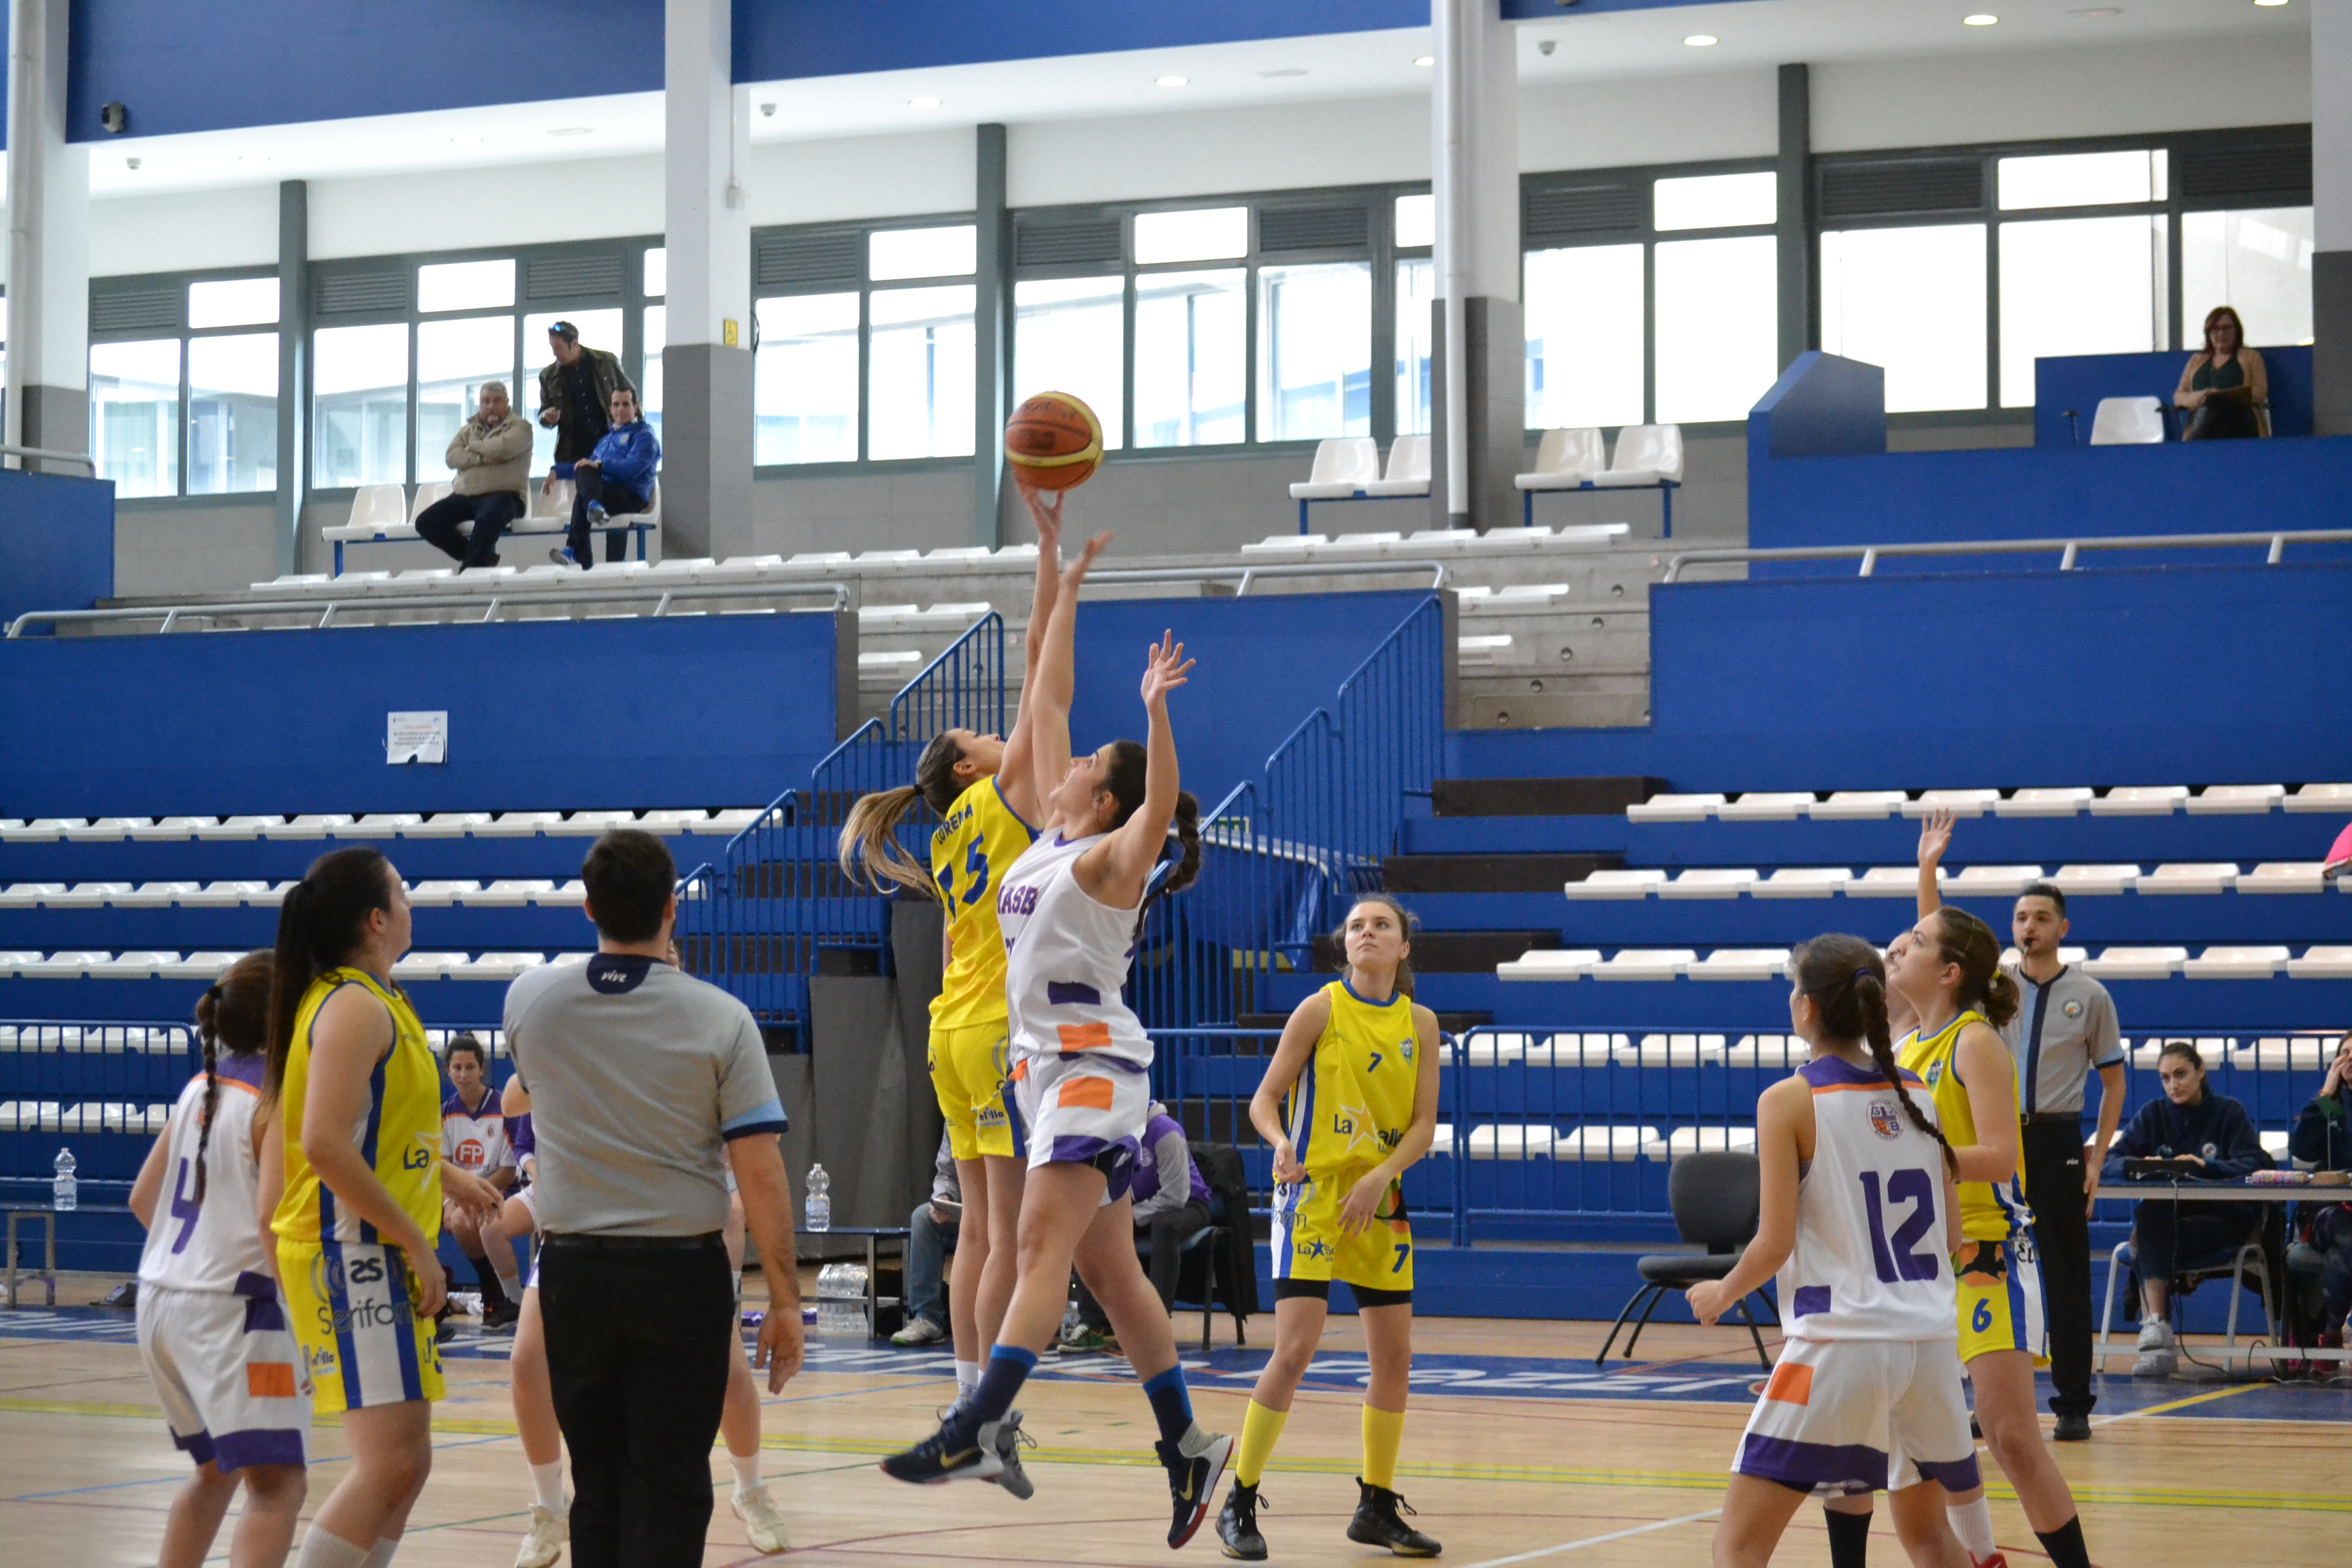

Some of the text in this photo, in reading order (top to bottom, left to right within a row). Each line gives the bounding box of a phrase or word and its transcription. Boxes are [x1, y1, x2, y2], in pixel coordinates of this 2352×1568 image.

[935, 804, 973, 845] LORENA
[936, 830, 989, 924] 15
[1367, 1051, 1382, 1073] 7
[1334, 1114, 1352, 1134] La
[404, 1144, 429, 1170] La
[459, 1144, 484, 1161] FP
[171, 1157, 200, 1254] 4
[1859, 1168, 1938, 1283] 12
[1392, 1243, 1410, 1273] 7
[1972, 1298, 1993, 1333] 6
